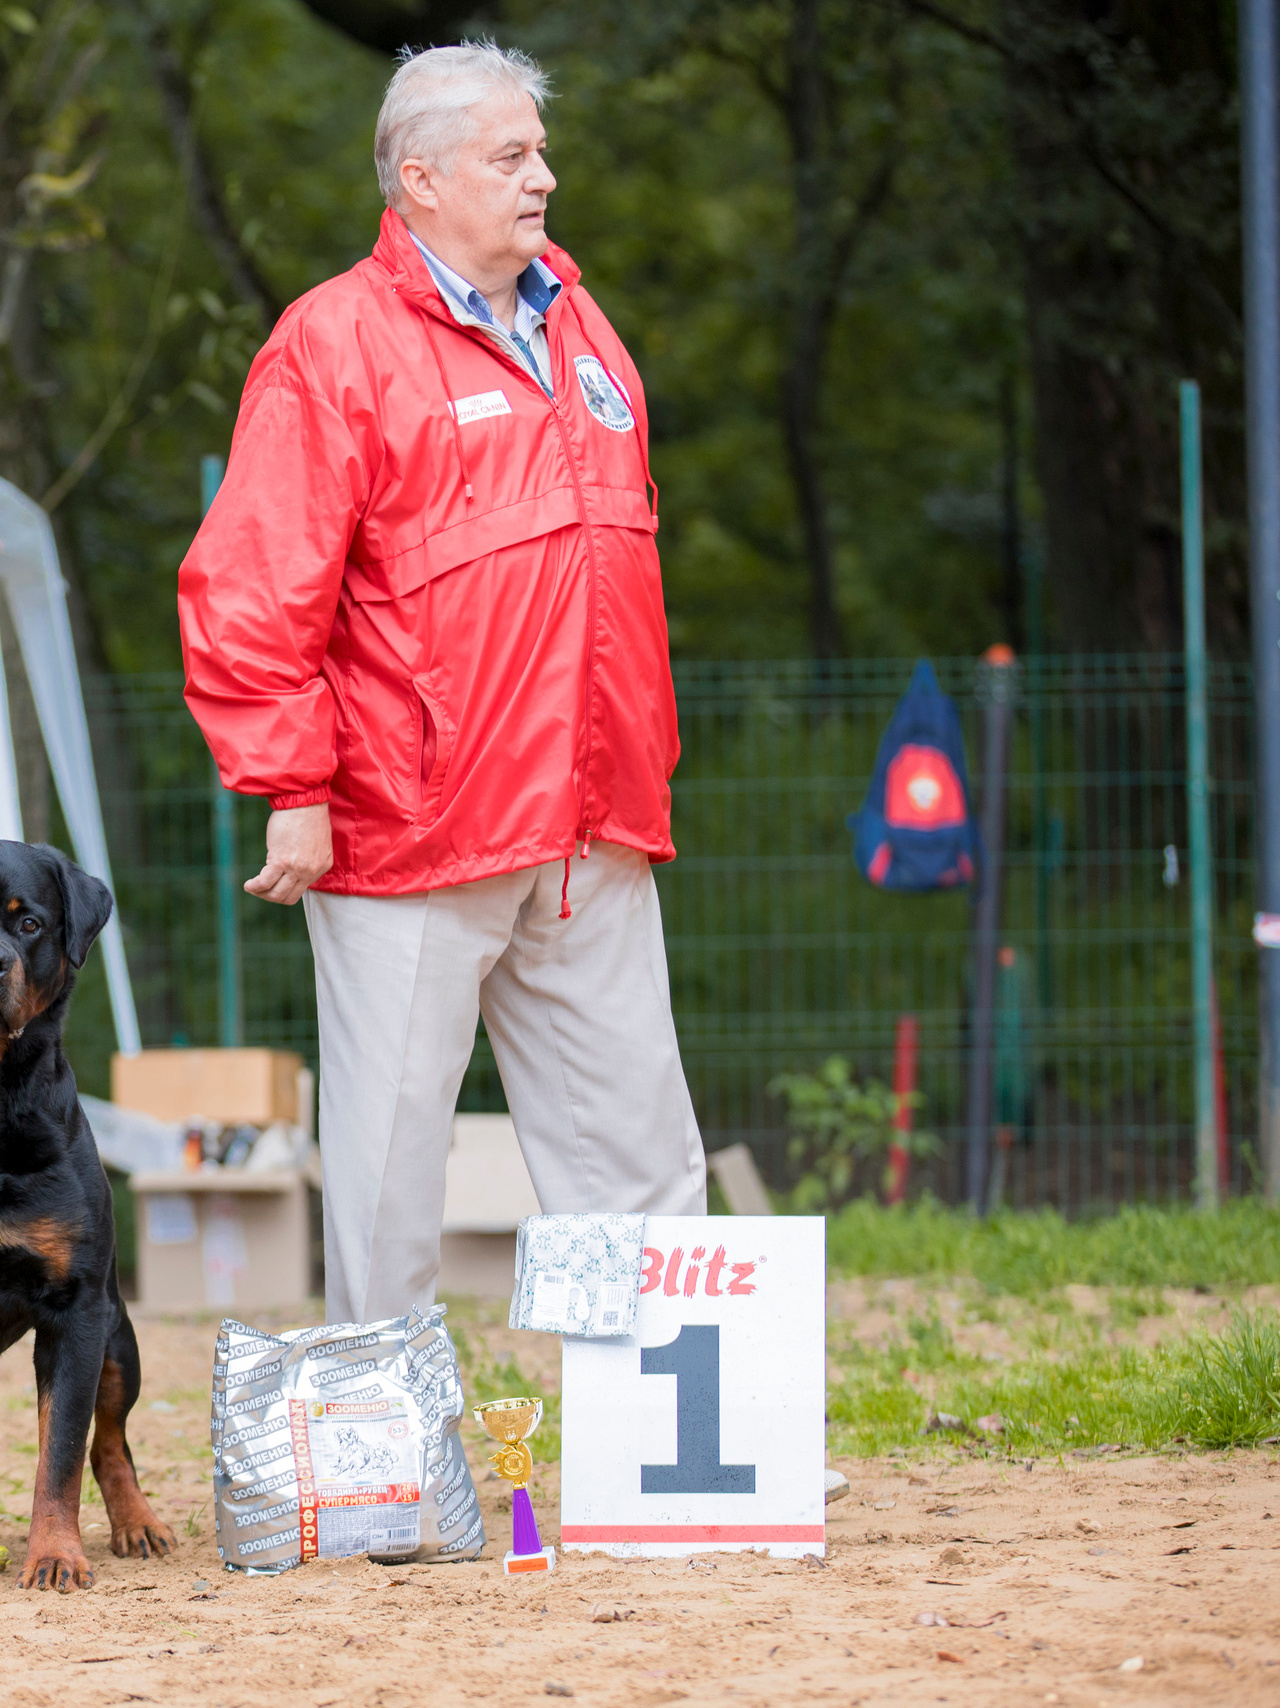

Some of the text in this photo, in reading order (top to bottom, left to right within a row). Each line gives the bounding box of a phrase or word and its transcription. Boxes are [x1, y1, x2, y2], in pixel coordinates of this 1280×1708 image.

[640, 1244, 758, 1299] Blitz
[308, 1333, 378, 1359] ЗООМЕНЮ
[311, 1360, 376, 1386] ЗООМЕНЮ
[223, 1390, 282, 1418] ООМЕНЮ
[326, 1401, 388, 1414] ЗООМЕНЮ
[641, 1324, 756, 1494] 1
[222, 1417, 287, 1448] ЗООМЕНЮ
[227, 1443, 292, 1476] ЗООМЕНЮ
[231, 1470, 296, 1501] ЗООМЕНЮ
[403, 1493, 412, 1502] 15
[235, 1498, 299, 1527] ЗООМЕНЮ
[319, 1495, 378, 1508] СУПЕРМЯСО
